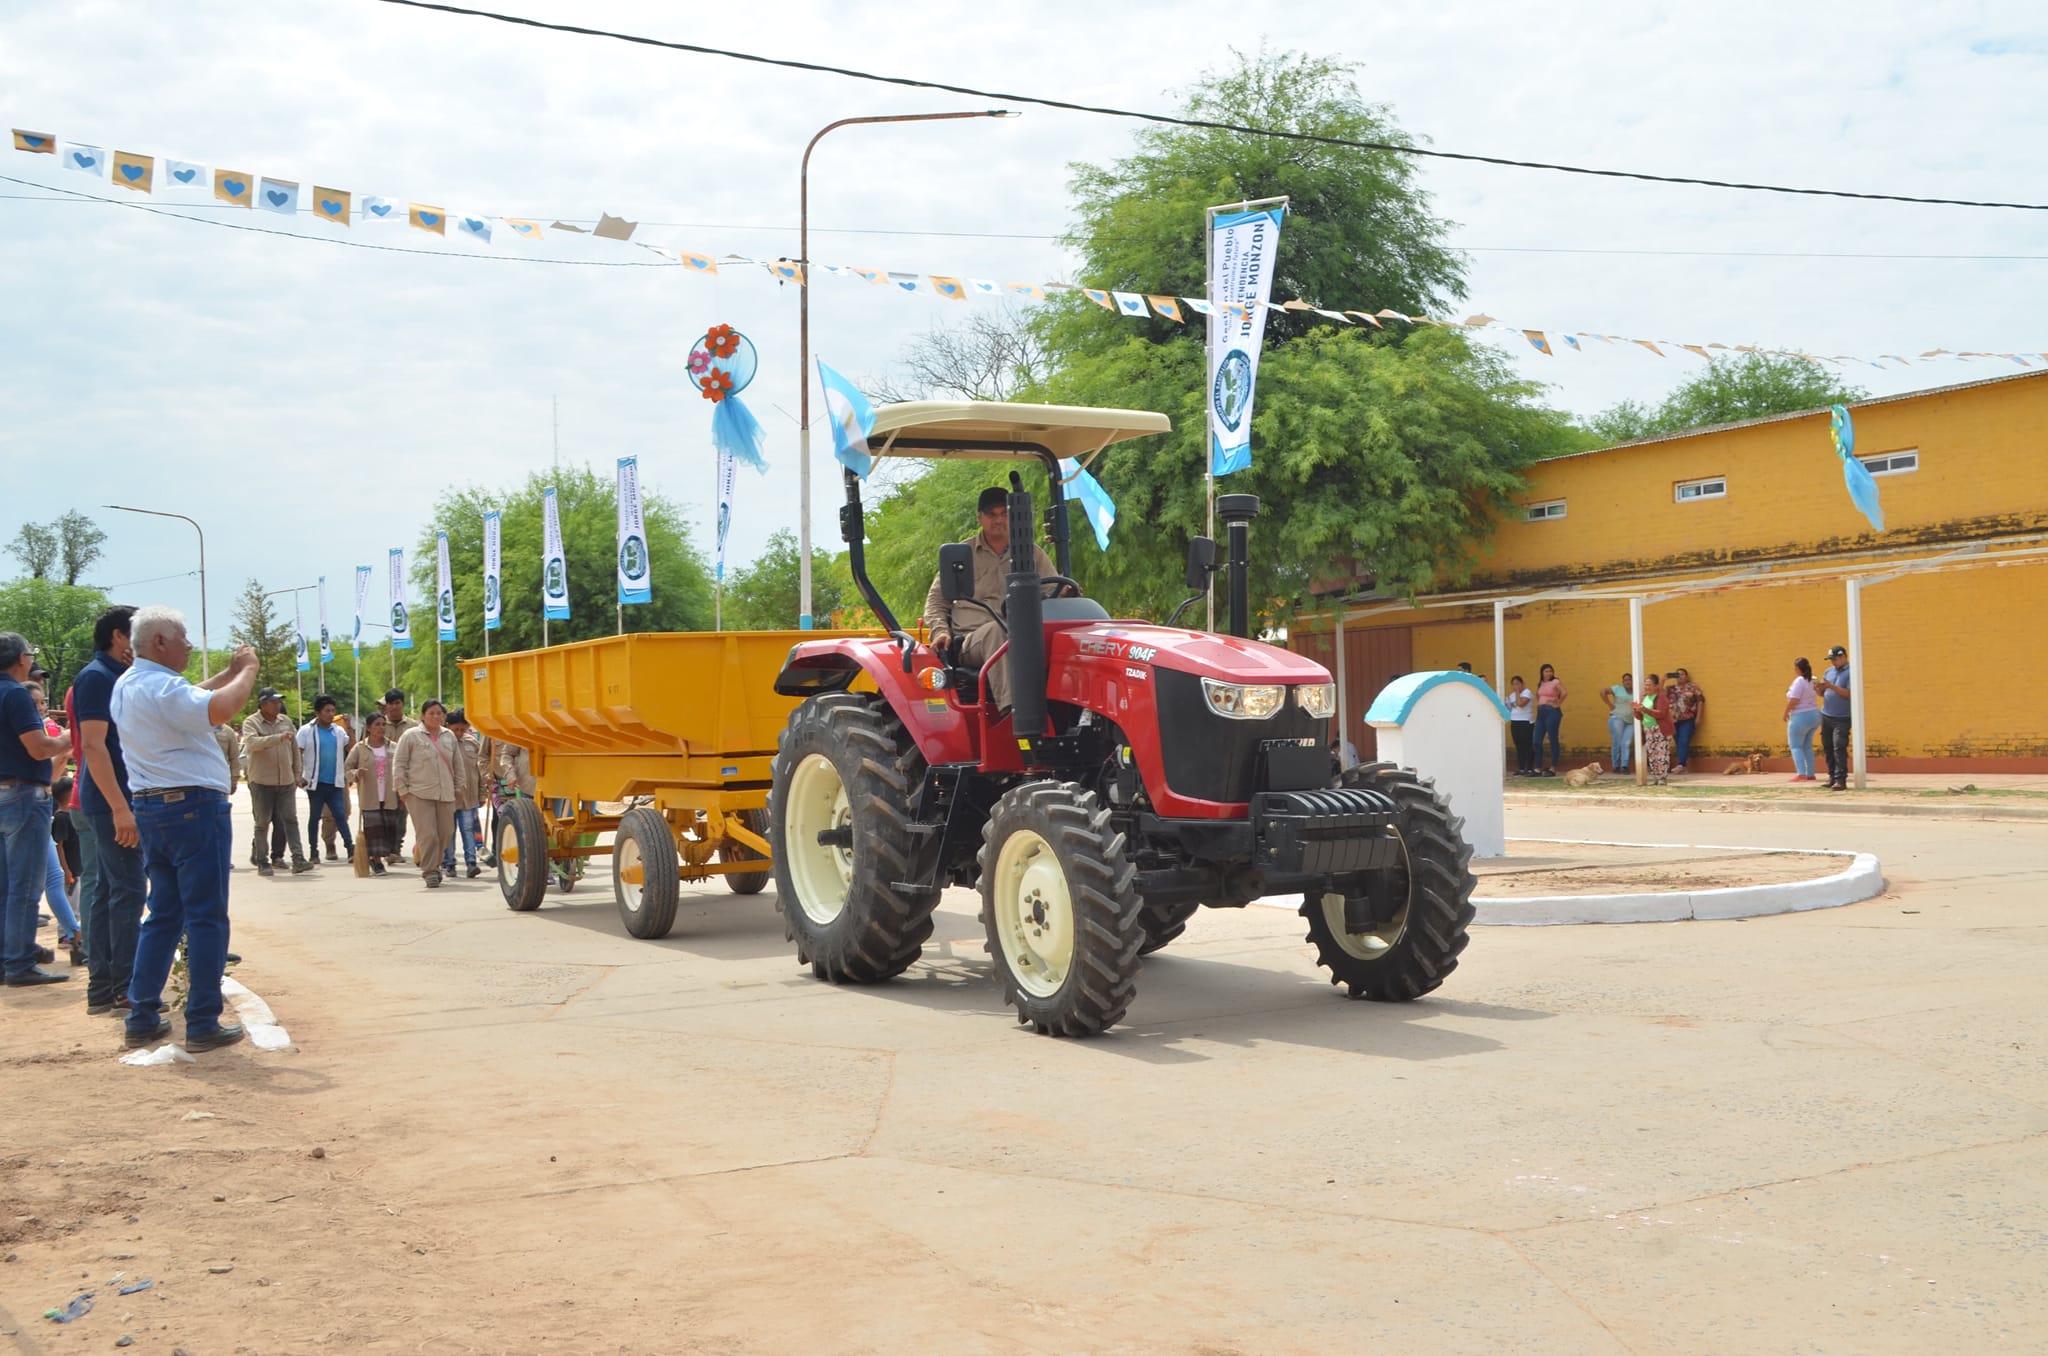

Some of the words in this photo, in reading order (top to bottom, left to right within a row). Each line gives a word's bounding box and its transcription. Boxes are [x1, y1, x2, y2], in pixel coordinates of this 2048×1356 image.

[1222, 228, 1235, 271] Pueblo
[1247, 223, 1265, 285] MONZON
[1222, 273, 1230, 293] del
[1237, 251, 1250, 304] TENDENCIA
[1080, 639, 1127, 656] CHERY
[1128, 645, 1157, 662] 904F
